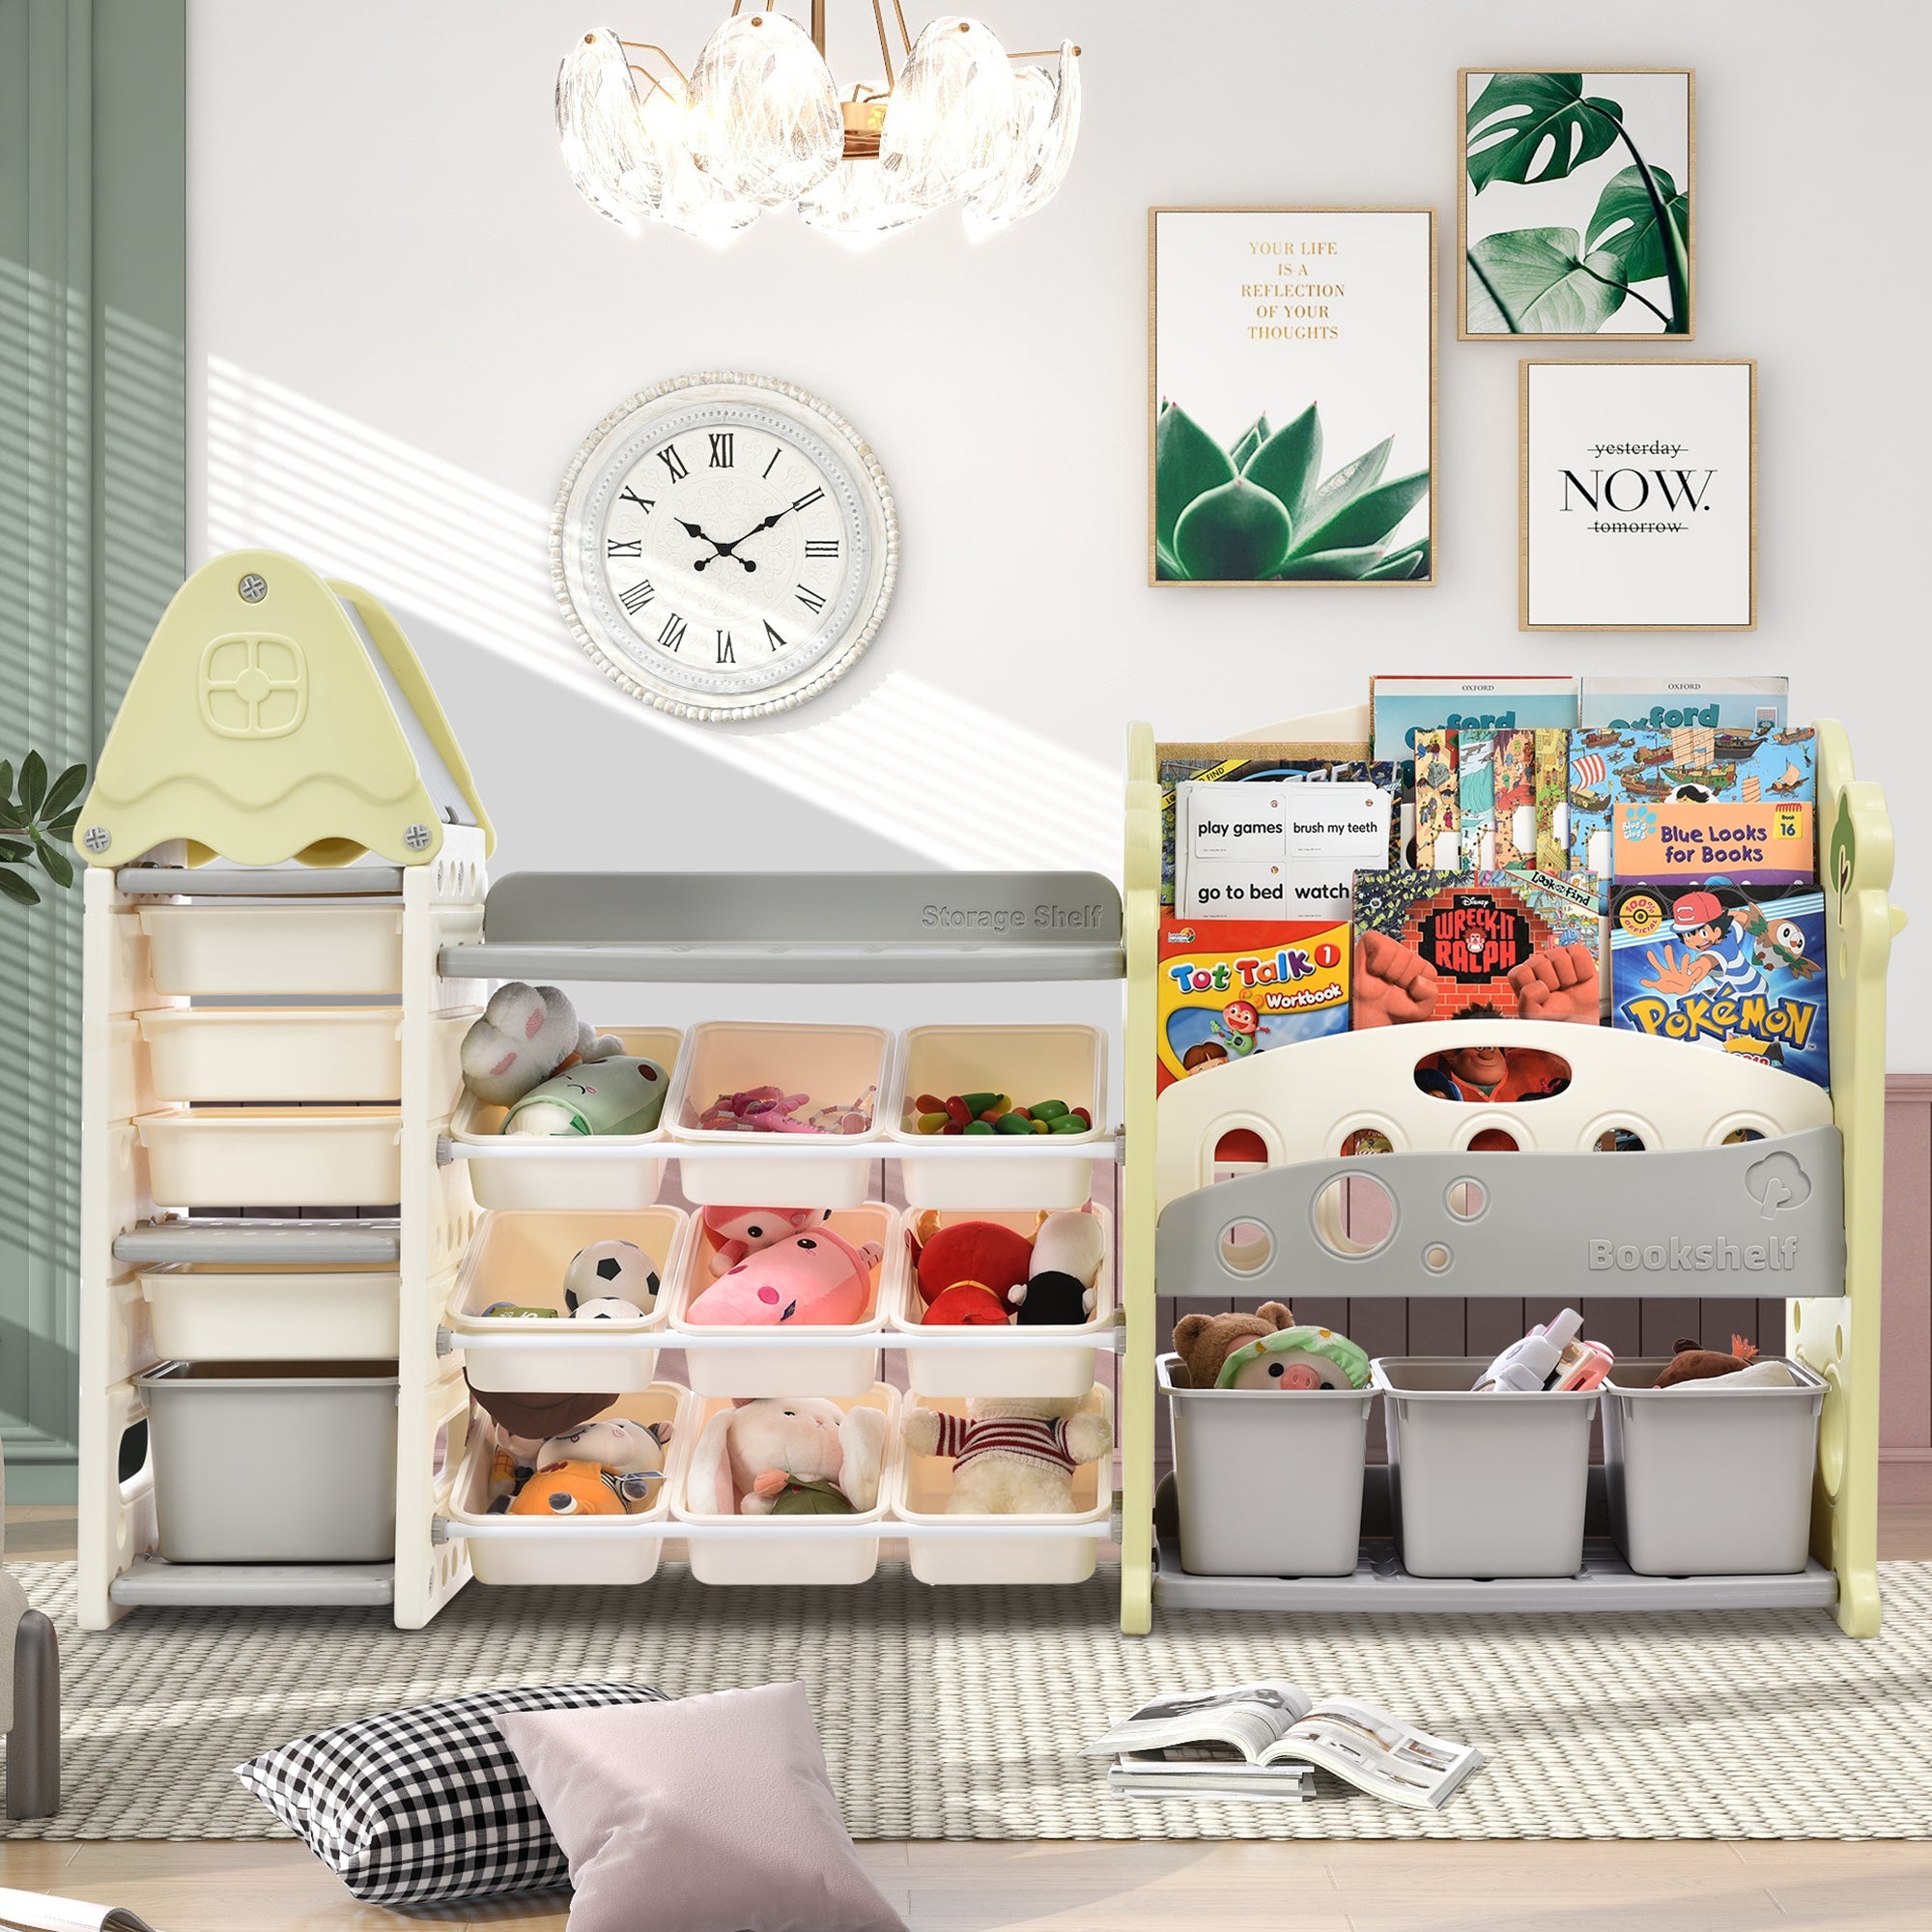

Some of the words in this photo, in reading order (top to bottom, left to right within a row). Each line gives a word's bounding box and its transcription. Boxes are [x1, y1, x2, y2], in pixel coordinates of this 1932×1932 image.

[1249, 242, 1294, 255] YOUR
[1301, 242, 1338, 255] LIFE
[1278, 263, 1293, 276] IS
[1298, 264, 1308, 276] A
[1241, 284, 1345, 298] REFLECTION
[1257, 305, 1278, 318] OF
[1284, 305, 1329, 319] YOUR
[1247, 326, 1339, 339] THOUGHTS
[708, 433, 734, 468] XII
[1594, 440, 1682, 459] yesterday
[656, 444, 691, 484] XI
[619, 485, 655, 514] X
[1557, 469, 1719, 512] NOW.
[1594, 521, 1682, 533] tomorrow
[608, 539, 641, 558] IX
[805, 540, 839, 557] III
[619, 580, 655, 615] VIII
[657, 612, 688, 652] VII
[762, 618, 787, 651] V
[716, 630, 736, 663] VI
[1198, 821, 1229, 838] play
[1233, 823, 1283, 838] games
[1293, 821, 1324, 833] brush
[1327, 824, 1345, 836] my
[1348, 821, 1378, 833] teeth
[1661, 826, 1703, 842] Blue
[1709, 825, 1768, 842] Looks
[1780, 823, 1796, 837] 16
[1665, 846, 1695, 864] for
[1702, 845, 1764, 864] Books
[1198, 888, 1221, 904] go
[1226, 885, 1244, 899] to
[1250, 883, 1283, 899] bed
[1294, 883, 1350, 899] watch
[1531, 871, 1555, 890] Look
[1565, 887, 1590, 906] Find
[1460, 895, 1490, 908] Disney
[1625, 898, 1656, 913] 100%
[922, 904, 1027, 935] Storage
[1034, 904, 1103, 929] Shelf
[1435, 908, 1516, 940] WRECK-IT
[1625, 920, 1658, 933] OFFICIAL
[1435, 941, 1517, 973] RALPH
[1169, 962, 1230, 992] Tot
[1323, 946, 1331, 964] 1
[1264, 983, 1342, 1009] Workbook
[1587, 1236, 1798, 1271] Bookshelf
